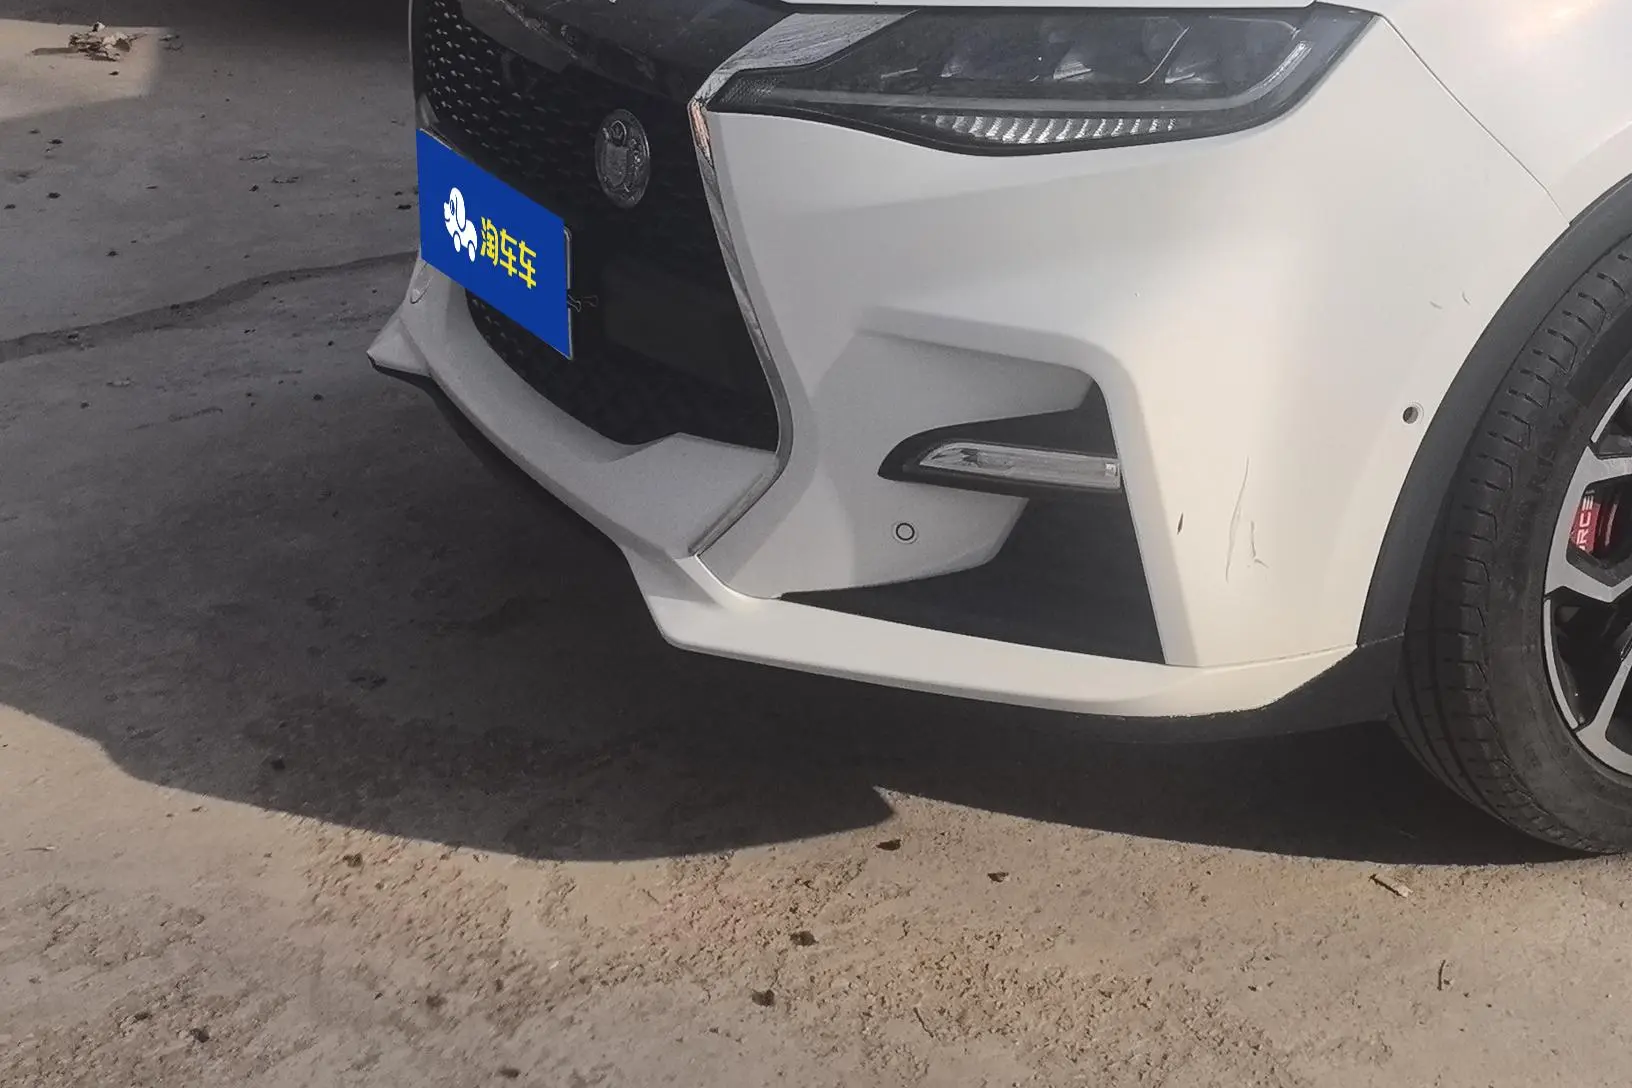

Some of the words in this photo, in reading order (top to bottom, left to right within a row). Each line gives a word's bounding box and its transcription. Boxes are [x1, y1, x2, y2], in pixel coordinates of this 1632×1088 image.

[480, 216, 537, 290] 淘车车
[1576, 489, 1595, 551] RCE
